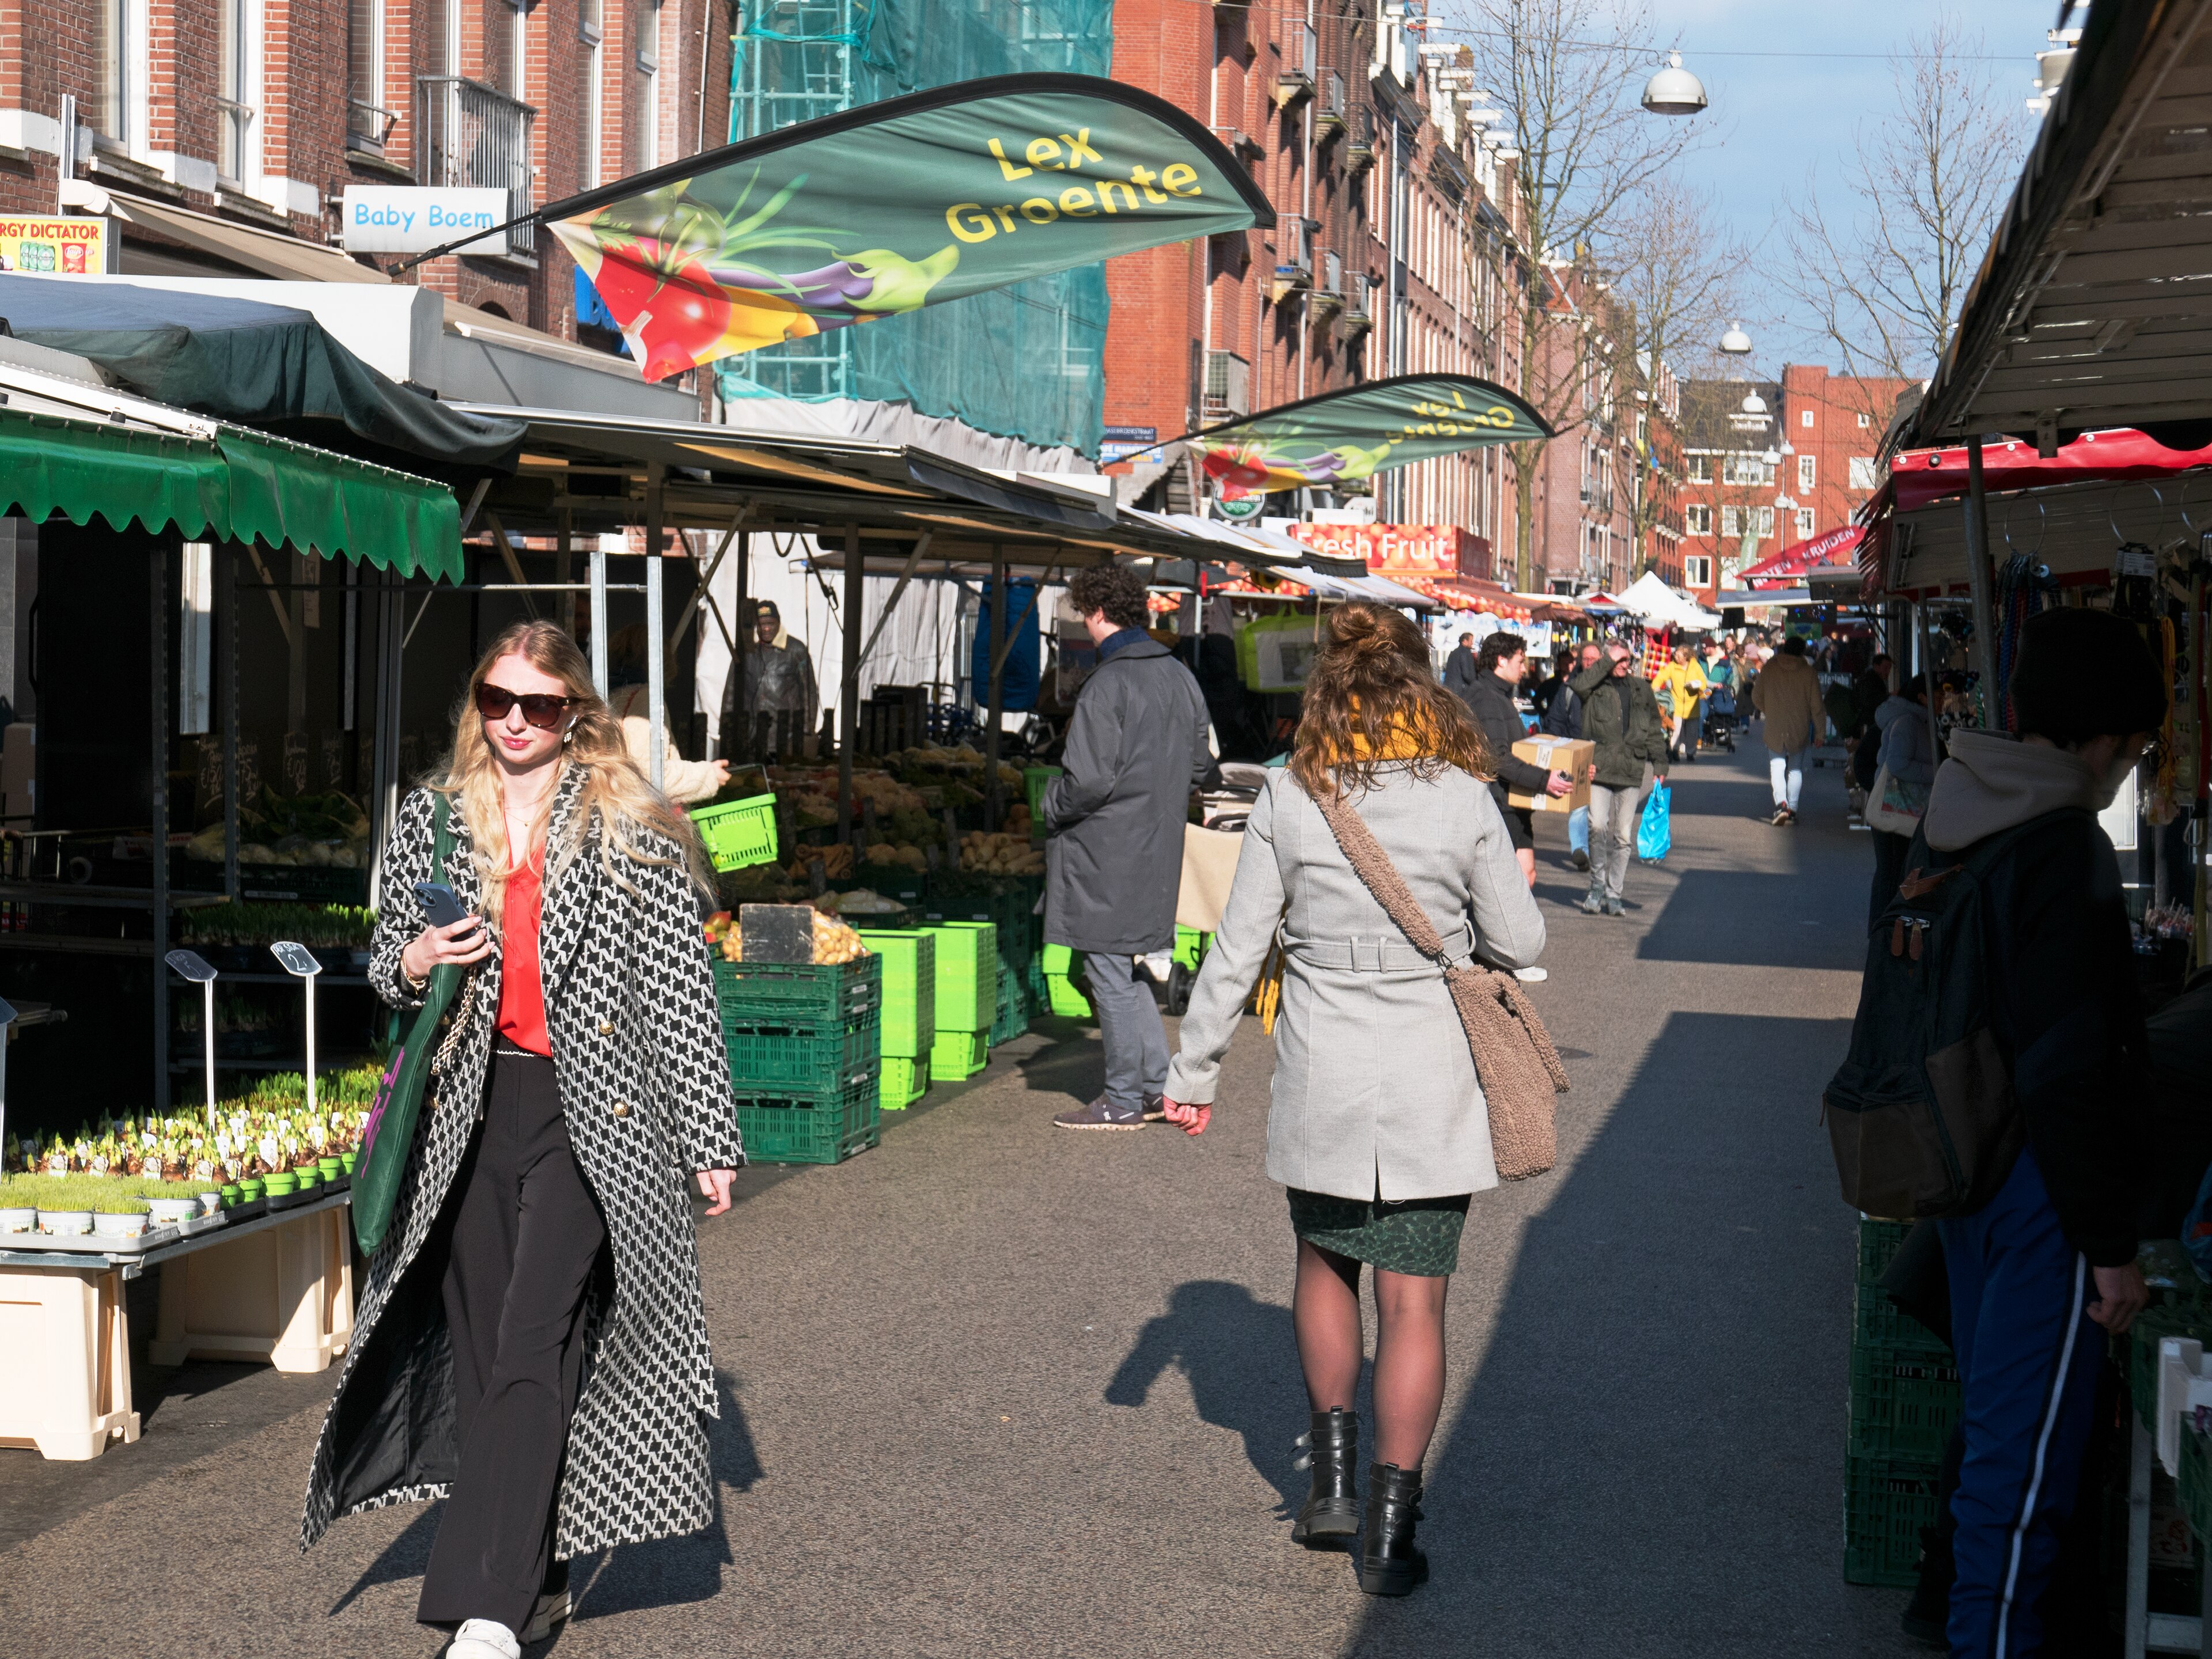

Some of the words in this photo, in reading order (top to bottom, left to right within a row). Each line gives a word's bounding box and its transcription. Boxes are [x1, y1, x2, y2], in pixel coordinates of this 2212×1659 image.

[987, 127, 1103, 181] Lex
[945, 162, 1202, 244] Groente
[31, 224, 99, 240] DICTATOR
[355, 204, 415, 233] Baby
[429, 205, 494, 228] Boem
[1297, 532, 1372, 559] Fresh
[1802, 529, 1855, 559] KRUIDEN
